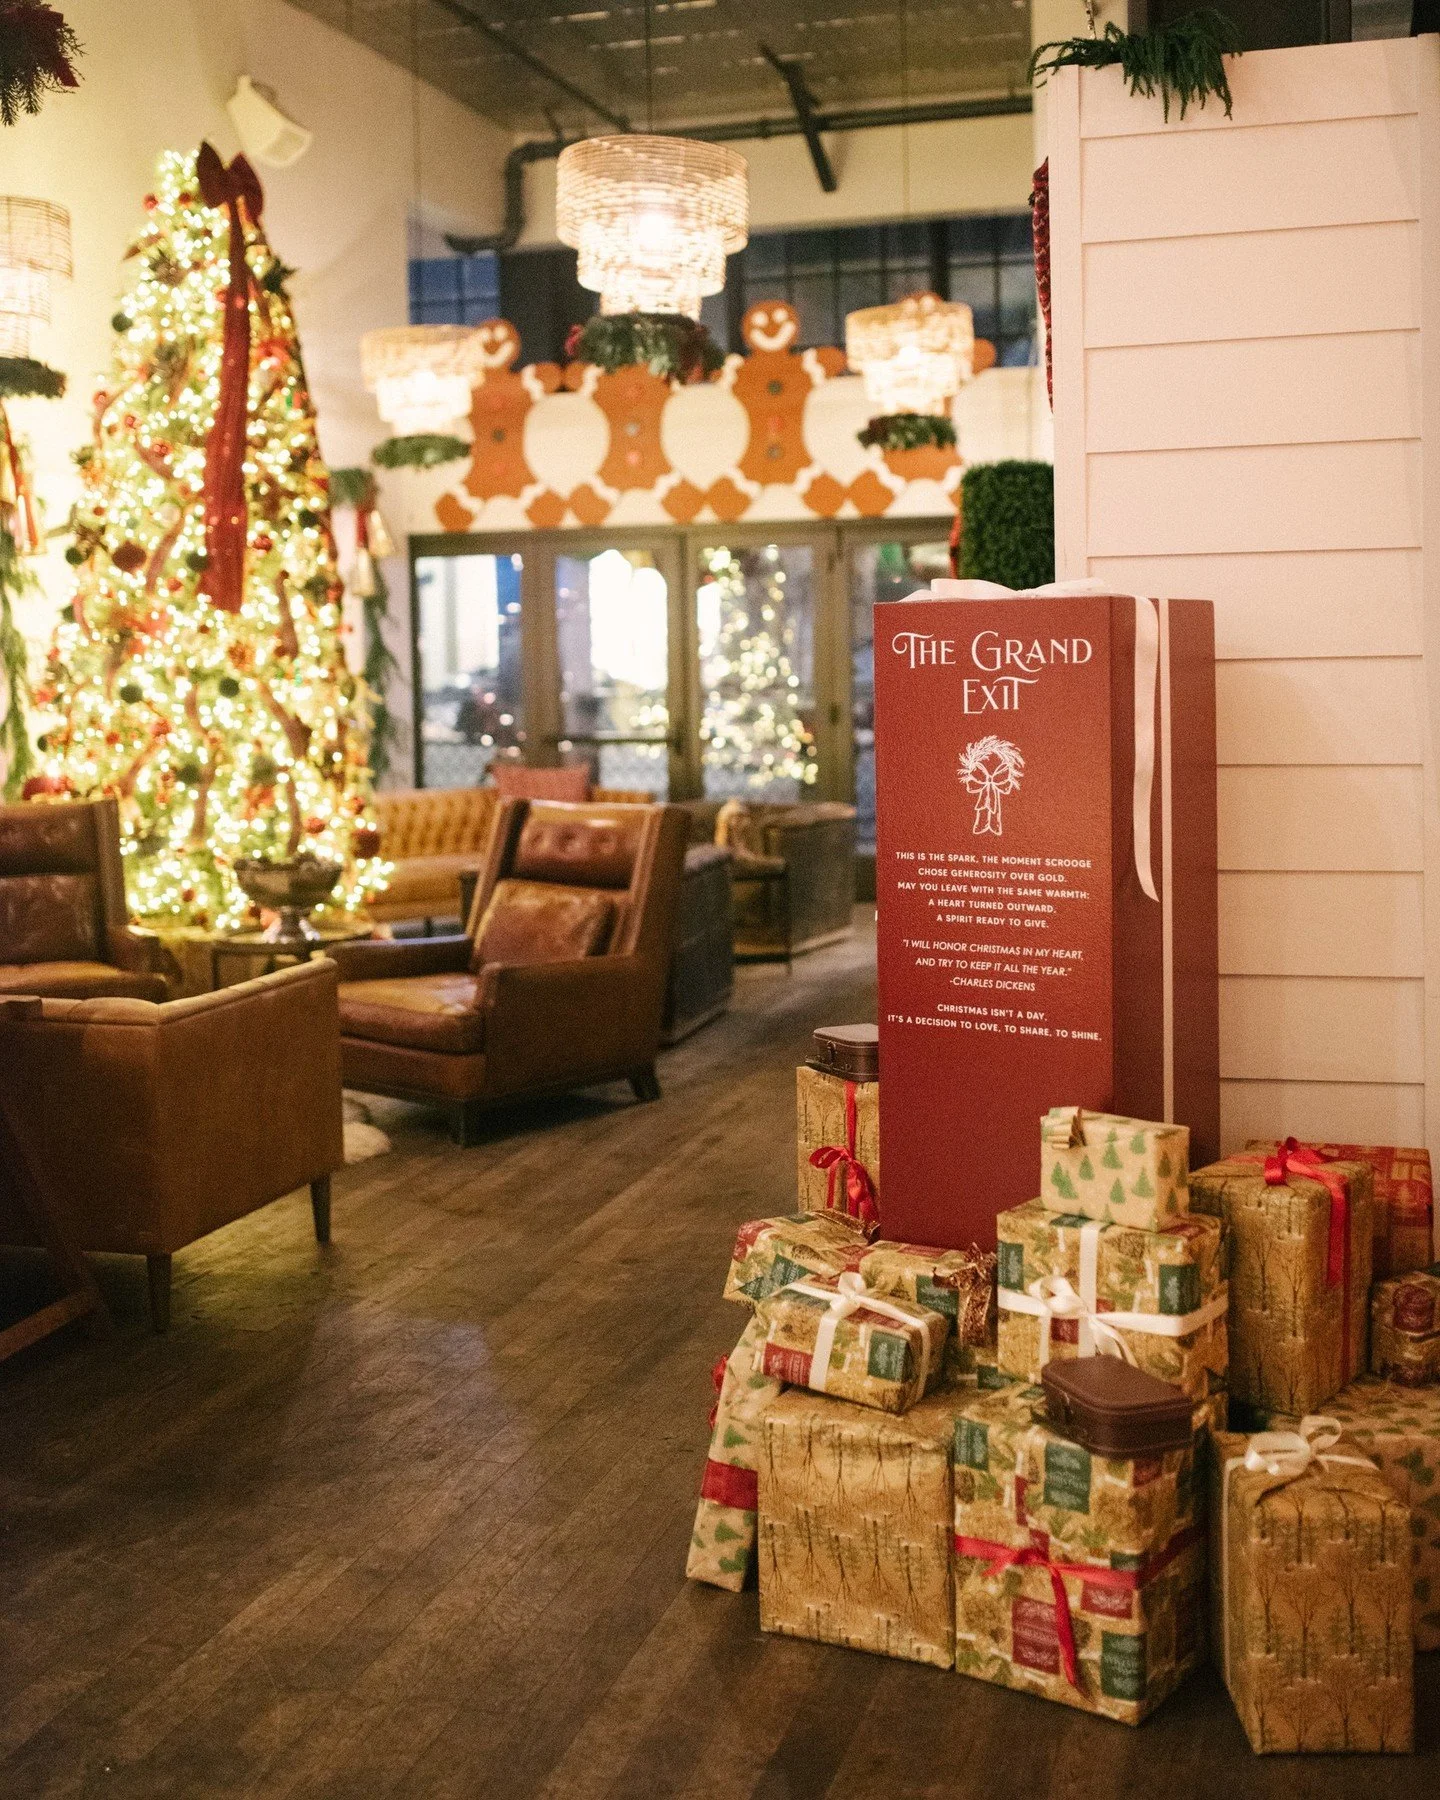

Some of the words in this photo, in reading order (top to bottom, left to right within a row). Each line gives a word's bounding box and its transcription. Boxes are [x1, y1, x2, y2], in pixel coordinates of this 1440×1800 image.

[896, 851, 915, 860] THIS
[918, 853, 926, 861] IS
[929, 853, 945, 861] THE
[982, 855, 998, 864] THE
[1001, 856, 1042, 866] MOMENT
[1045, 858, 1092, 868] SCROOGE
[918, 868, 948, 877] CHOSE
[951, 869, 1007, 880] GENEROSITY
[1010, 872, 1035, 881] OVER
[1038, 873, 1067, 882] GOLD.
[897, 882, 916, 890] MAY
[919, 883, 938, 891] YOU
[941, 884, 968, 893] LEAVE
[971, 885, 994, 894] WITH
[997, 887, 1014, 895] THE
[1017, 888, 1042, 897] SAME
[1045, 890, 1090, 899] WARMTH:
[938, 899, 966, 908] HEART
[969, 901, 1003, 910] TURNED
[936, 914, 943, 922] A
[946, 914, 973, 923] SPIRIT
[976, 916, 1006, 925] READY
[1009, 918, 1021, 927] TO
[1024, 919, 1049, 928] GIVE.
[911, 940, 930, 949] WILL
[932, 941, 967, 951] HONOR
[970, 943, 1021, 955] CHRISTMAS
[1022, 947, 1032, 956] IN
[1035, 948, 1050, 957] MY
[915, 958, 936, 967] AND
[938, 958, 954, 968] TRY
[956, 959, 968, 969] TO
[970, 961, 992, 970] KEEP
[993, 963, 1002, 971] IT
[1003, 964, 1020, 973] ALL
[1022, 964, 1038, 974] THE
[1041, 966, 1072, 976] YEAR."
[949, 977, 993, 988] -CHARLES
[995, 981, 1036, 991] DICKENS
[936, 1004, 988, 1015] CHRISTMAS
[991, 1008, 1014, 1017] ISN'T
[1016, 1011, 1023, 1019] A
[887, 1014, 904, 1023] IT'S
[906, 1016, 913, 1024] A
[915, 1017, 957, 1028] DECISION
[960, 1021, 972, 1029] TO
[1004, 1024, 1016, 1033] TO
[1056, 1029, 1068, 1038] TO
[1071, 1031, 1102, 1041] SHINE.
